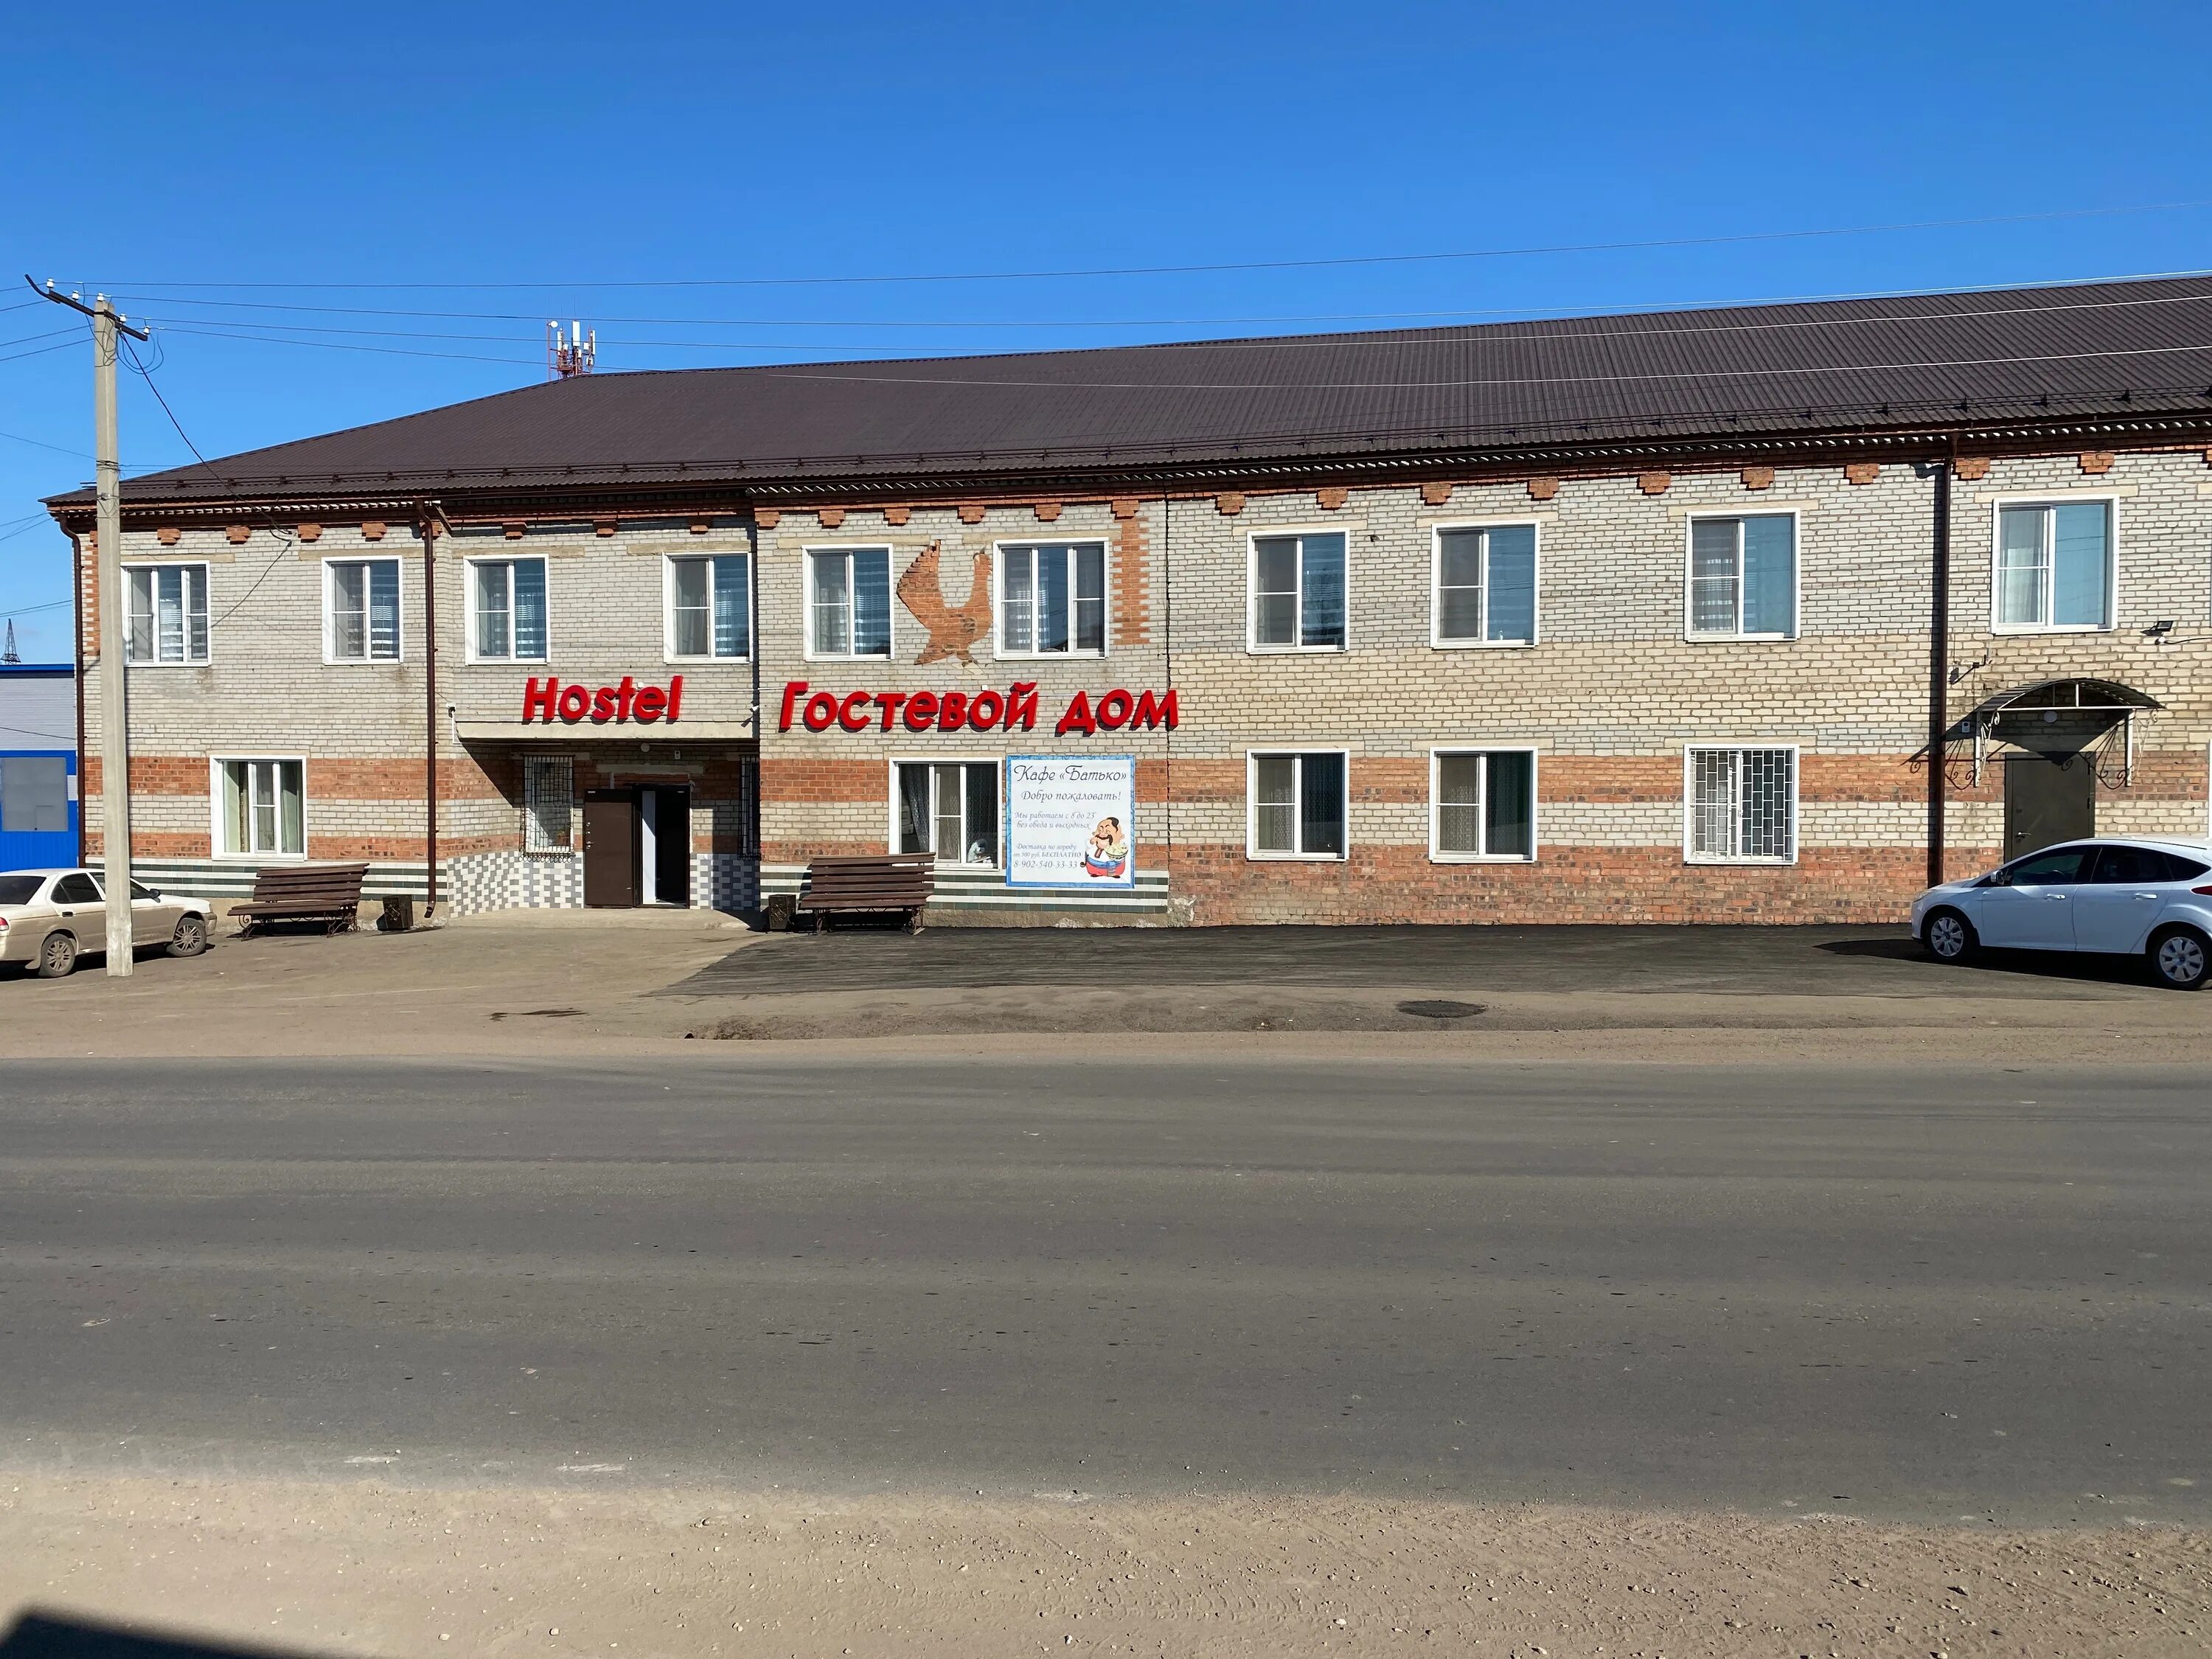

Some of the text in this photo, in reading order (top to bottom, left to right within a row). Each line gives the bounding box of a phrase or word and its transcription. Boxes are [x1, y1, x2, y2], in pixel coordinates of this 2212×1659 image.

[522, 675, 684, 723] Hostel
[779, 681, 1038, 732] Гостевой
[1014, 765, 1127, 785] Кафе «Батько»
[1021, 790, 1121, 803] Добро пожаловать!
[1030, 811, 1063, 821] работаем
[1017, 820, 1028, 828] без
[1029, 820, 1047, 828] обеда
[1055, 820, 1091, 830] выходных
[1057, 844, 1077, 852] городу
[1014, 860, 1077, 869] 8-902-540-33-33
